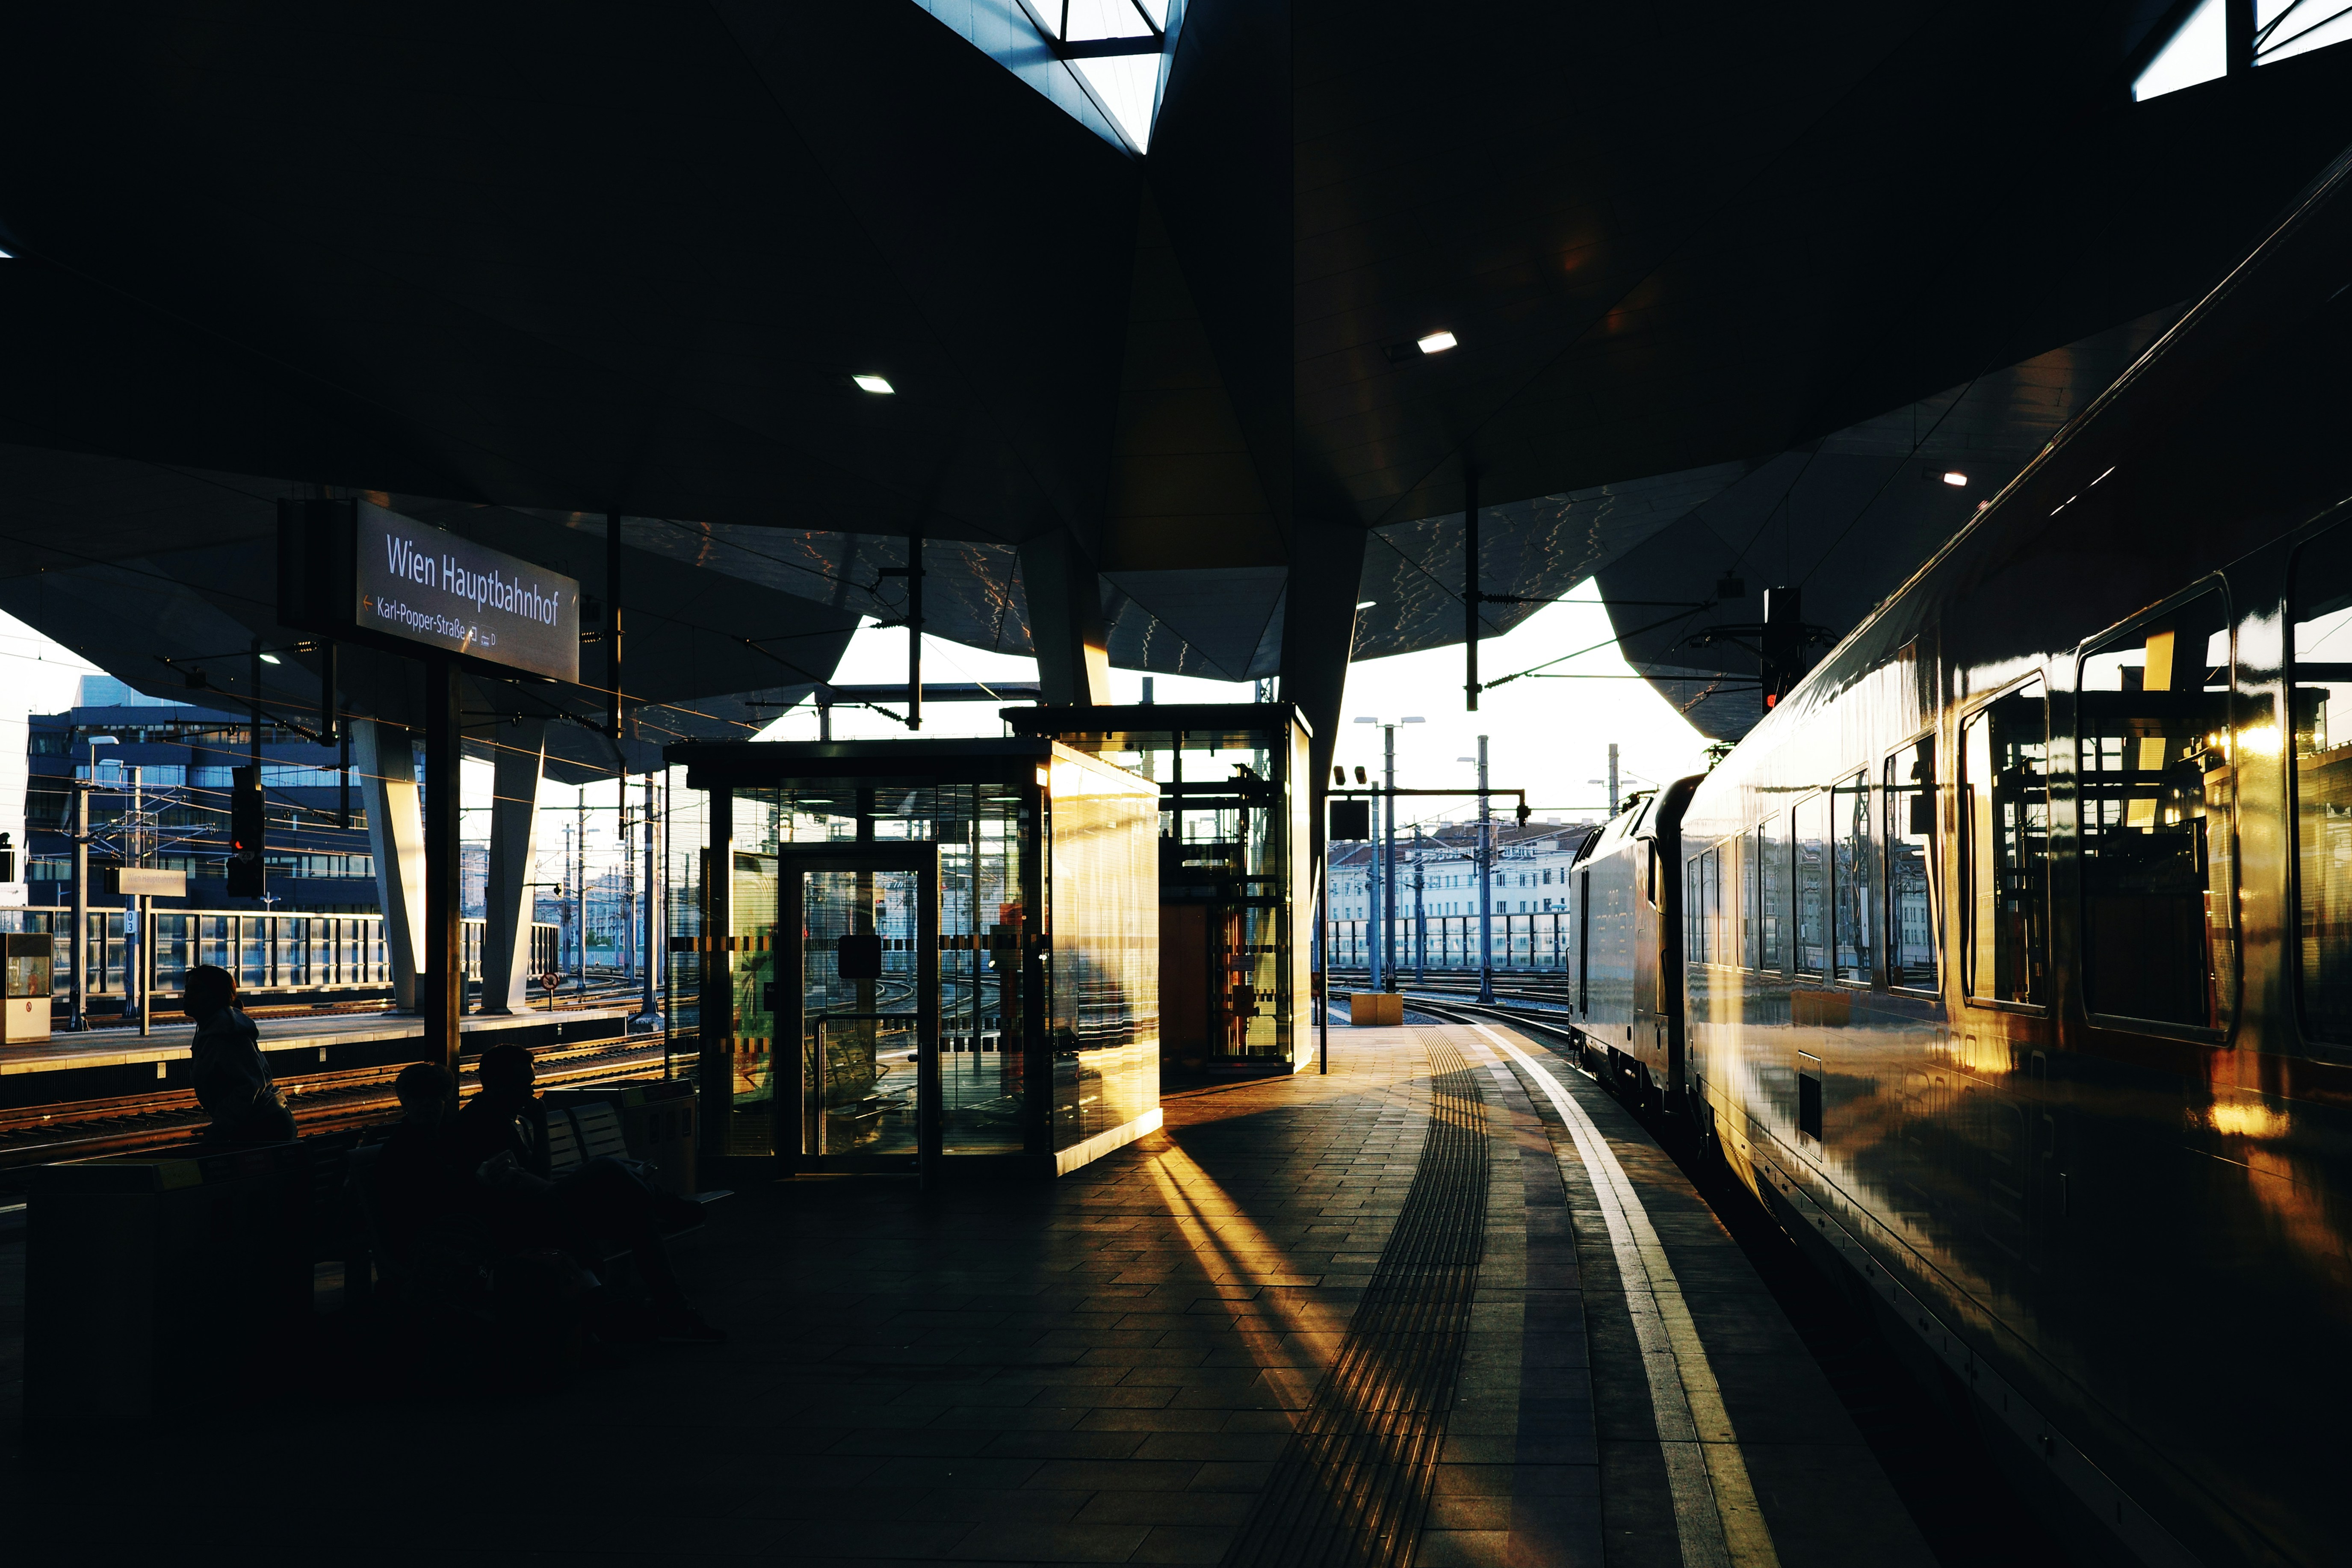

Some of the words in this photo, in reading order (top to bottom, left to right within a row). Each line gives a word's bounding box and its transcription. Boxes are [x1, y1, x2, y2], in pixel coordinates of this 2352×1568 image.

[387, 534, 435, 587] Wien
[443, 554, 558, 626] Hauptbahnhof
[378, 596, 465, 640] Karl-Popper-Straße
[491, 633, 496, 645] D
[127, 874, 141, 883] Wien
[142, 874, 179, 885] Hauptbahnhof
